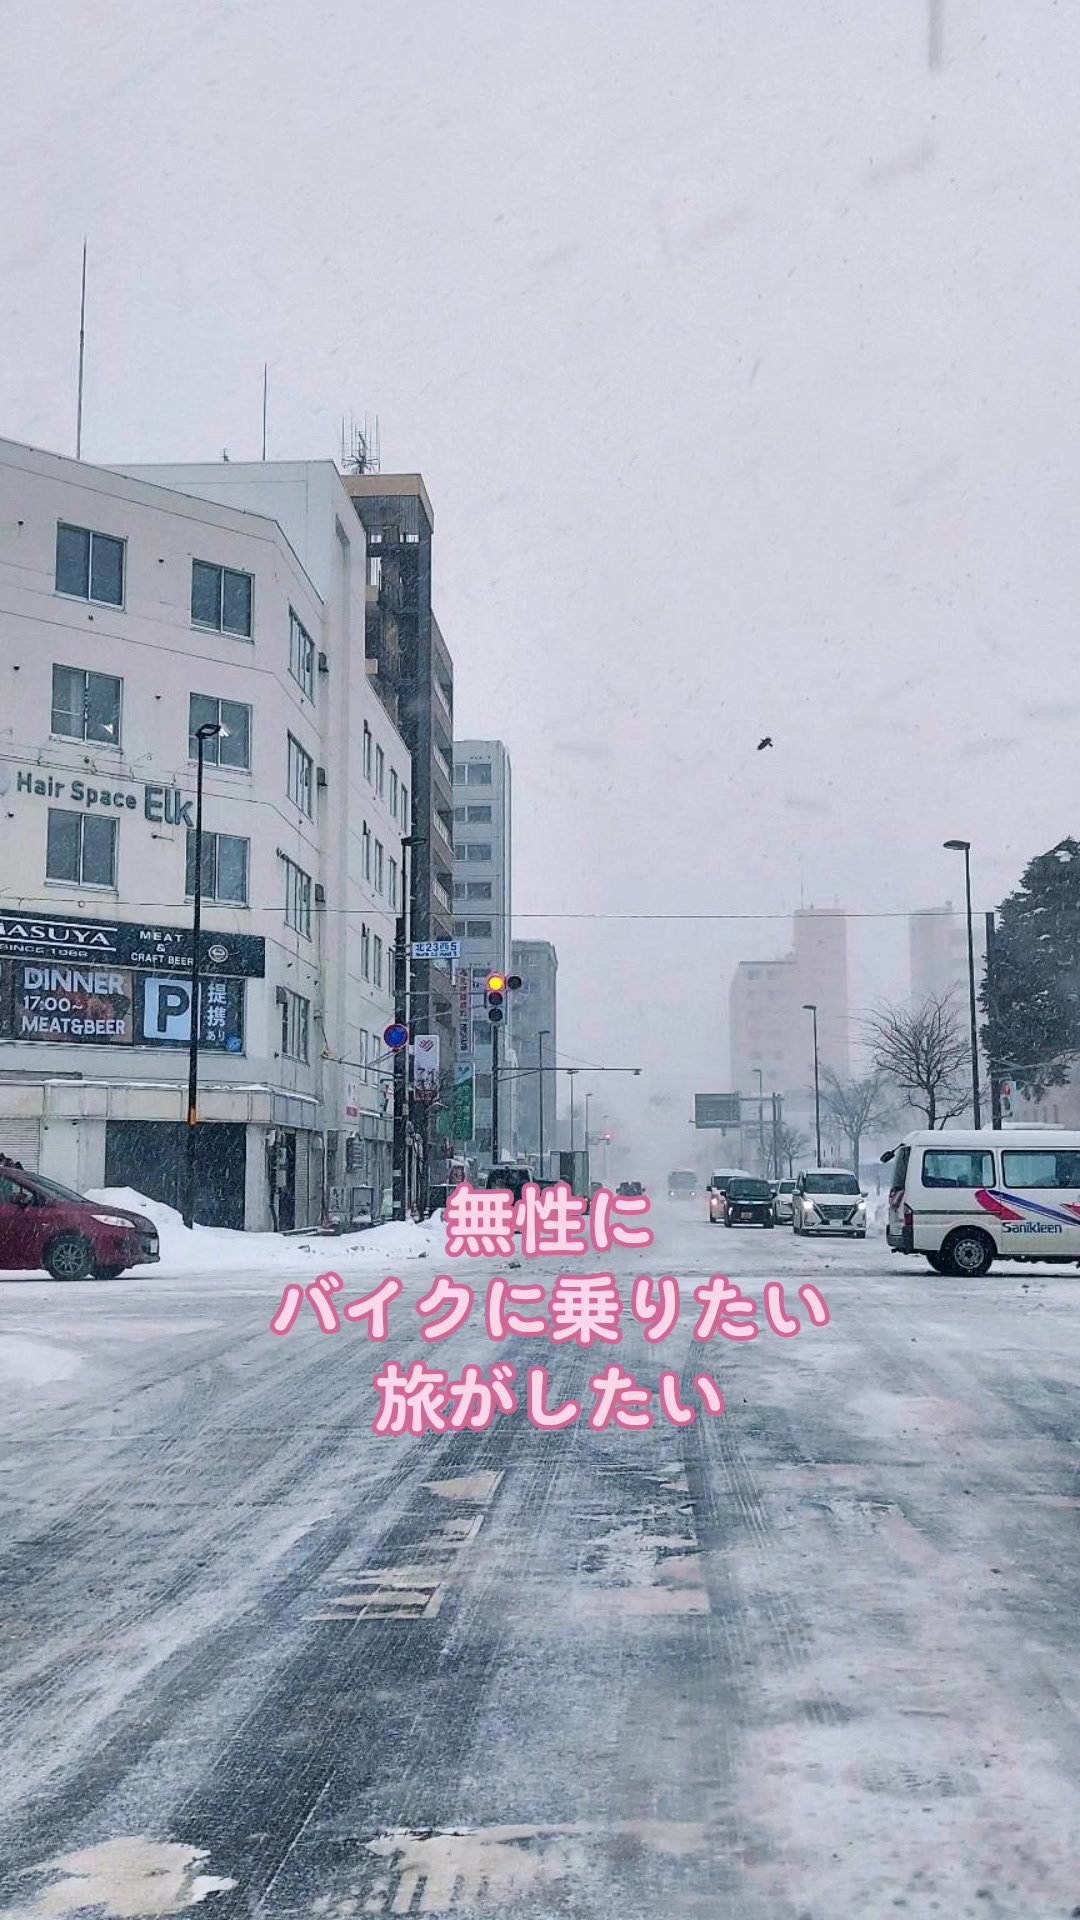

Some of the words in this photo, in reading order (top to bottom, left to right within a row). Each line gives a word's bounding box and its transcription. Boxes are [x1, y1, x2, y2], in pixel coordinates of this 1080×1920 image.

[17, 771, 65, 798] Hair
[71, 780, 137, 809] Space
[144, 785, 194, 828] Elk
[140, 931, 183, 942] MEAT
[0, 943, 45, 954] SINCE
[156, 944, 166, 953] &
[415, 941, 457, 952] 北23西5
[130, 952, 164, 963] CRAFT
[168, 955, 194, 966] BEER
[24, 967, 125, 995] DINNER
[157, 984, 190, 1033] P
[207, 983, 227, 1027] 提携
[22, 1015, 126, 1035] MEAT&BEER
[206, 1030, 225, 1041] あり
[1002, 1221, 1062, 1234] Sanikleen
